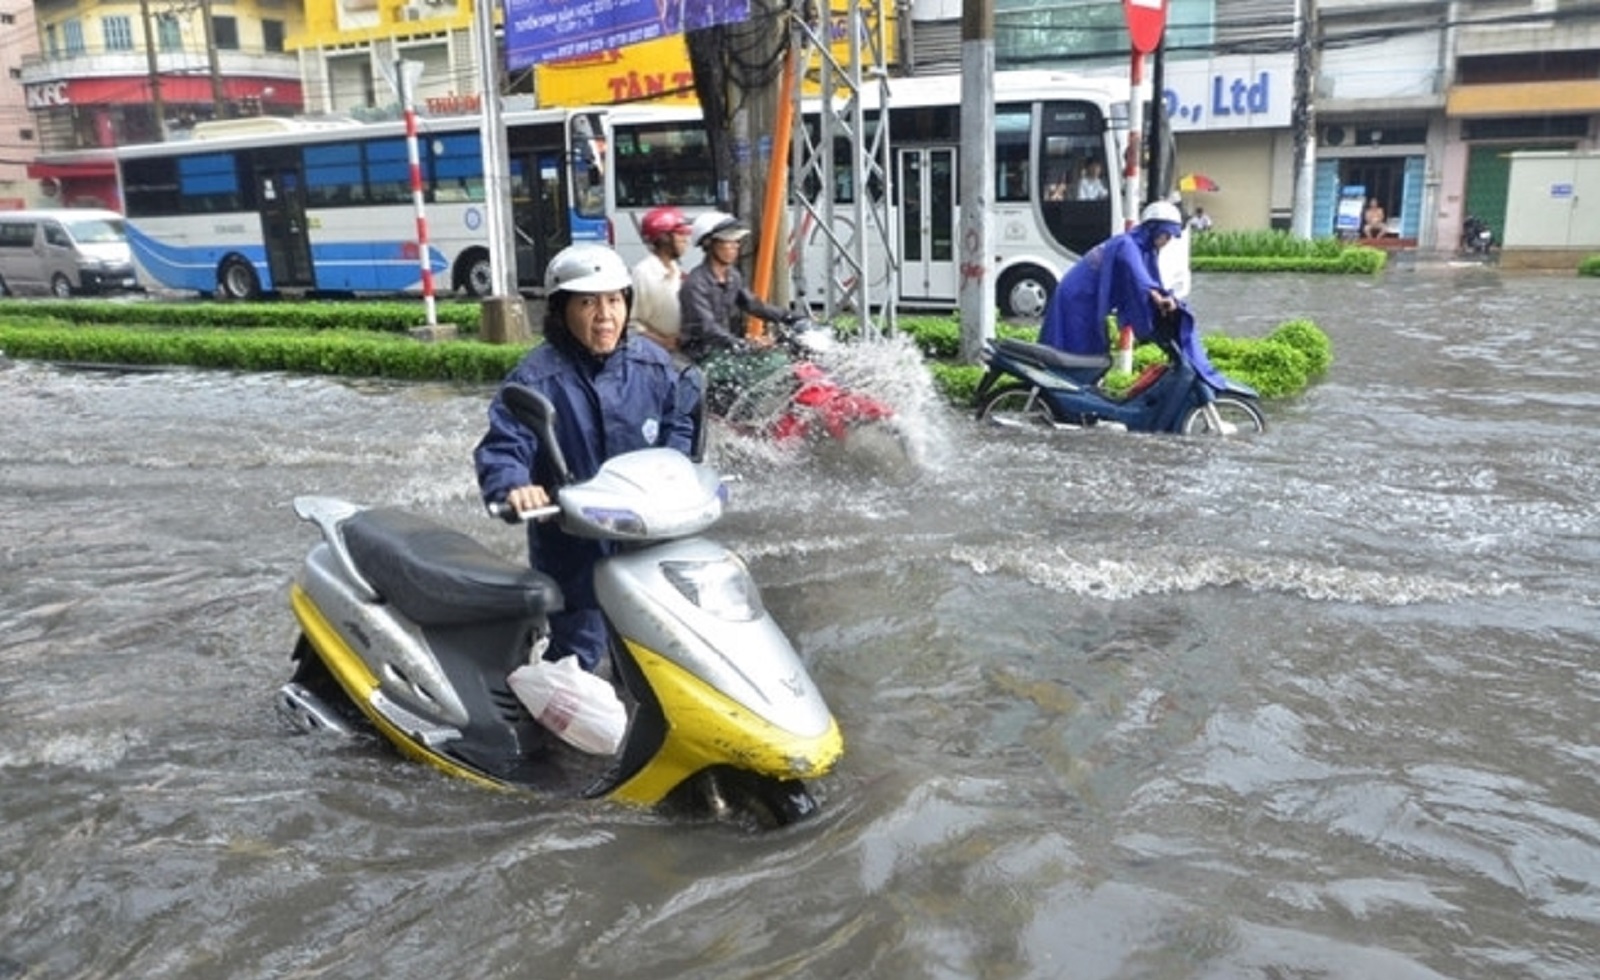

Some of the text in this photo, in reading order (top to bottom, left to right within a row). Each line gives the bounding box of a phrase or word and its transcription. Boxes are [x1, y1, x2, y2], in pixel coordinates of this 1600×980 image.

[28, 83, 69, 107] KFC
[609, 72, 693, 101] TÂN T
[1213, 73, 1268, 114] Ltd
